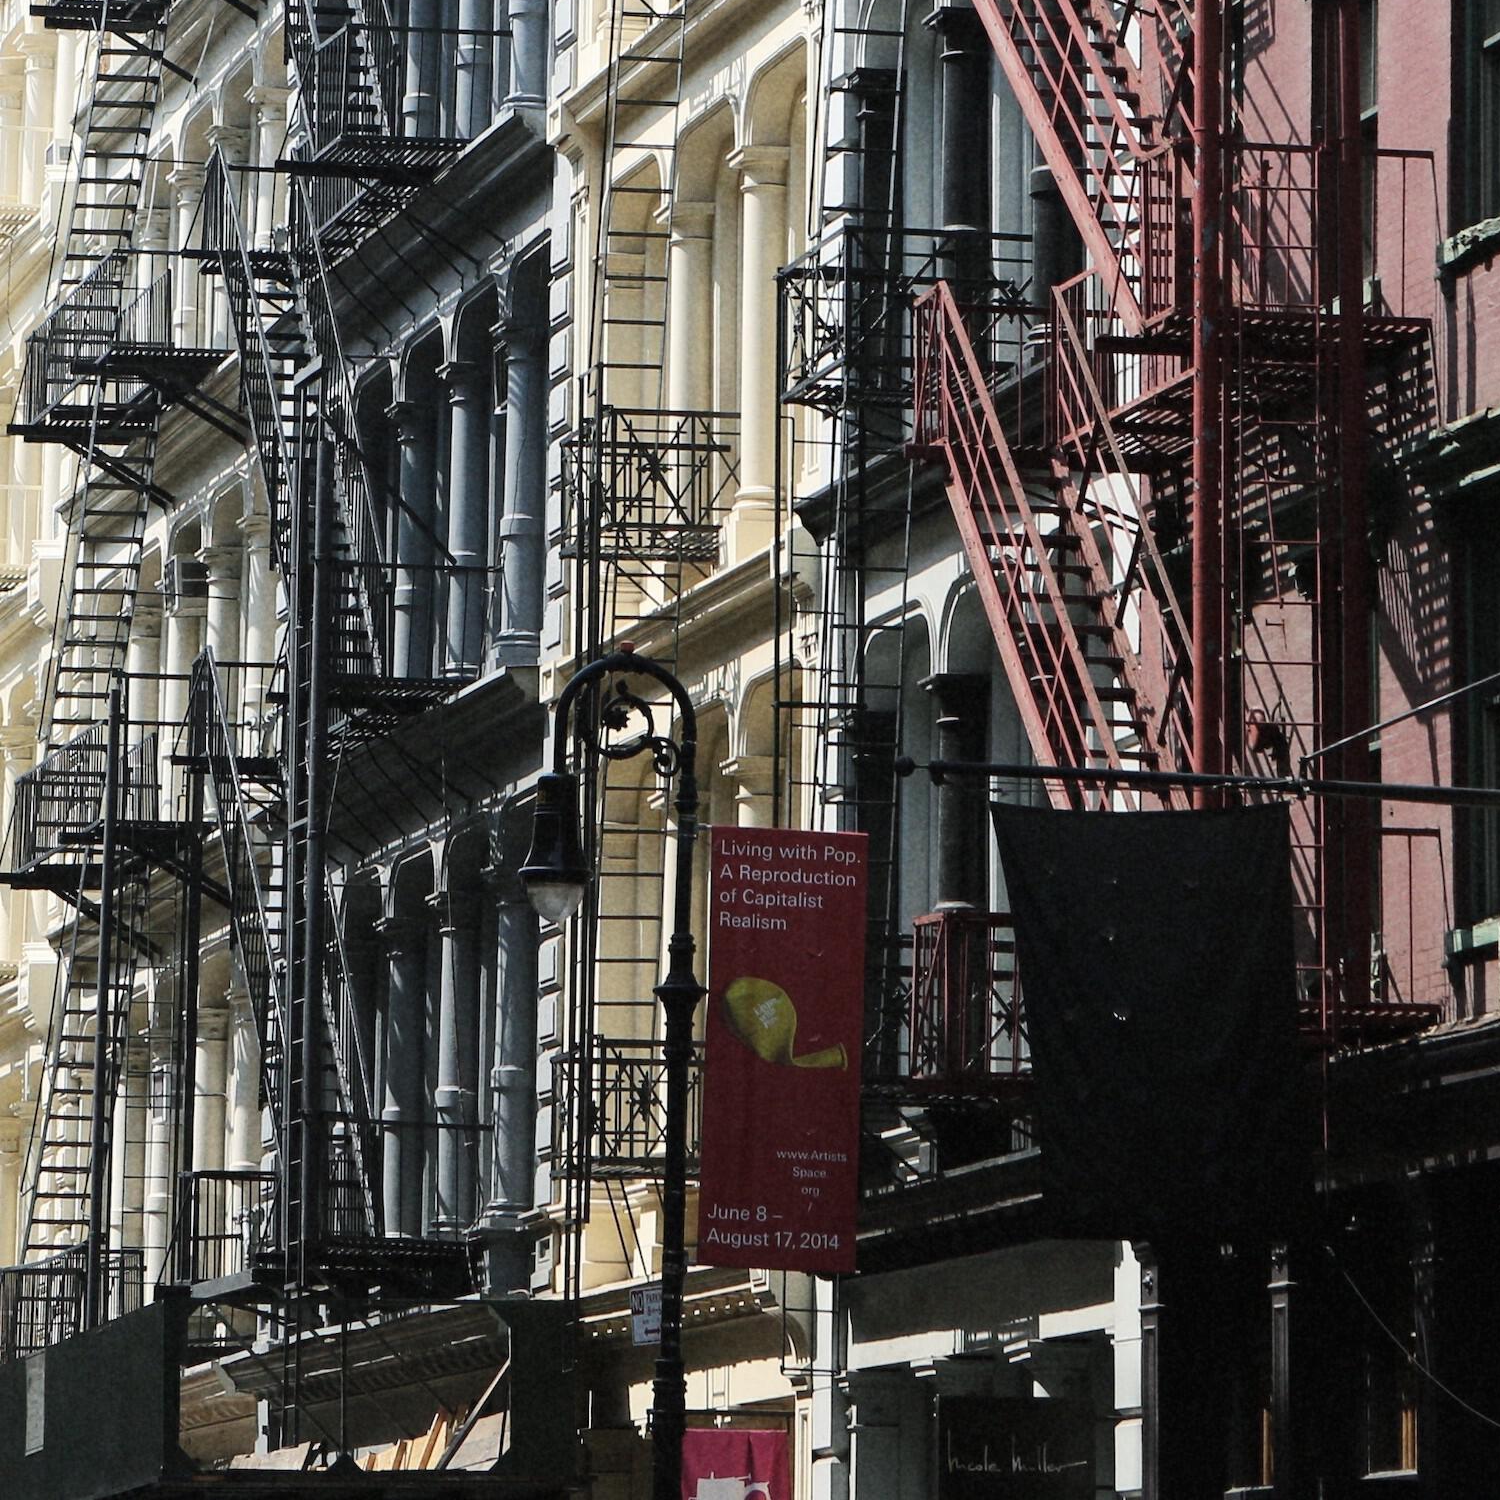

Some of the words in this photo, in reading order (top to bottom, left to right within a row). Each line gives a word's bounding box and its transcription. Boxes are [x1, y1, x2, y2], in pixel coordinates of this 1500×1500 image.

[721, 839, 773, 861] Living
[779, 844, 817, 861] with
[824, 846, 861, 866] Pop.
[719, 863, 733, 880] A
[739, 864, 857, 887] Reproduction
[719, 888, 737, 904] of
[742, 889, 824, 909] Capitalist
[719, 911, 787, 931] Realism
[801, 1186, 820, 1197] org
[707, 1203, 751, 1221] June
[755, 1205, 768, 1222] 8
[706, 1227, 769, 1249] August
[774, 1231, 796, 1250] 17,
[799, 1232, 840, 1250] 2014
